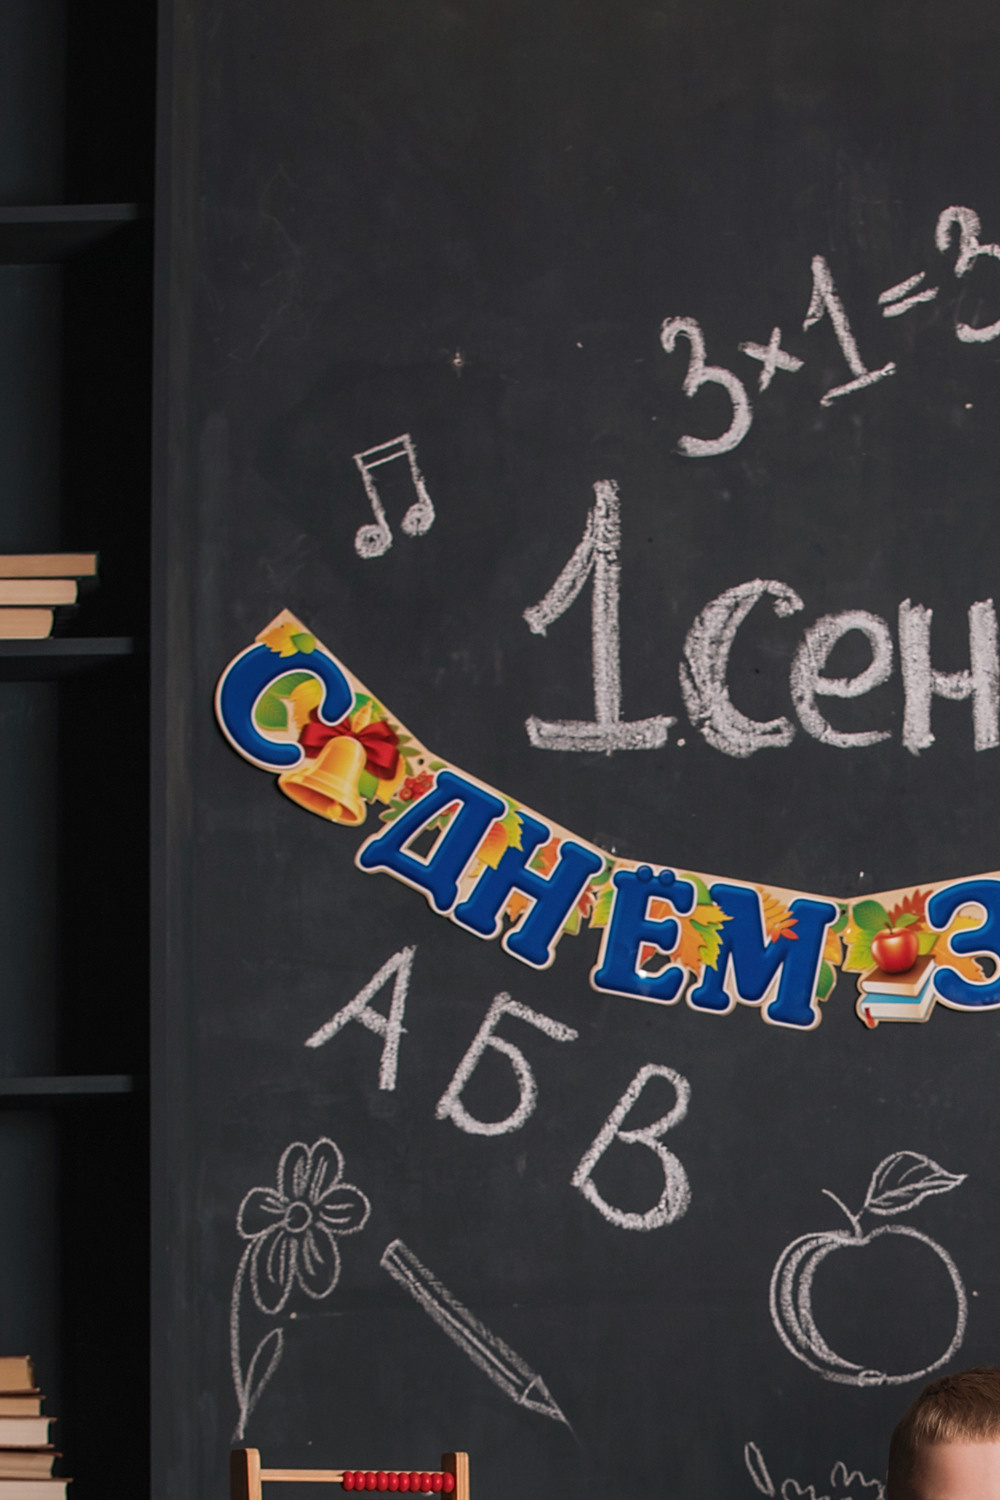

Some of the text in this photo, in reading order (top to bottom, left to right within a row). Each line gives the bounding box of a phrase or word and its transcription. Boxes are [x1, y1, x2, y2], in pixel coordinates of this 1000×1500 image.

[214, 638, 352, 774] С
[355, 768, 840, 1030] ДНЁМ
[303, 943, 693, 1232] А Б В
